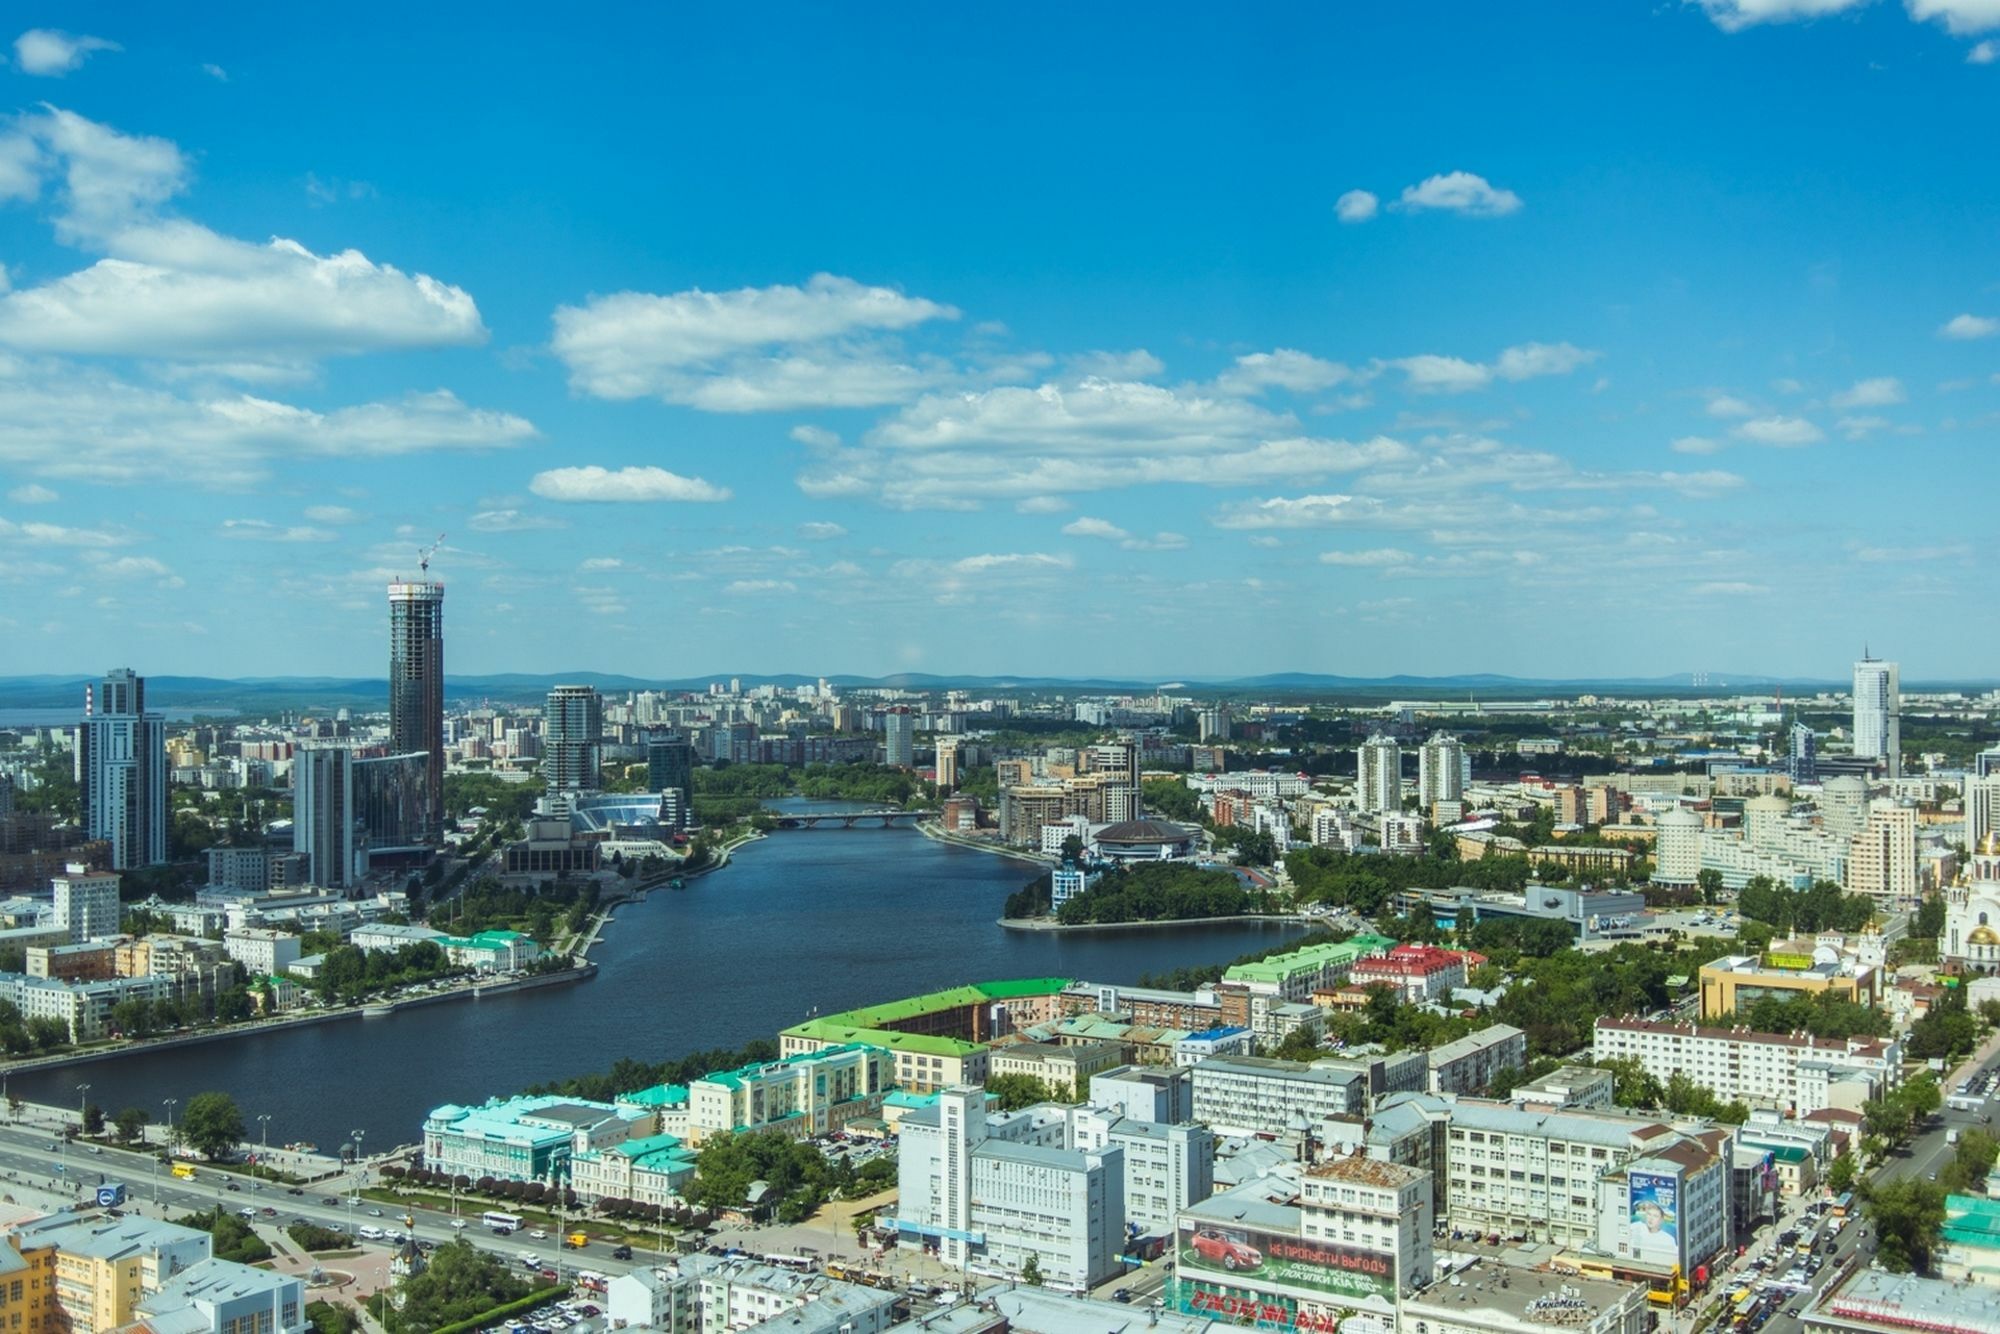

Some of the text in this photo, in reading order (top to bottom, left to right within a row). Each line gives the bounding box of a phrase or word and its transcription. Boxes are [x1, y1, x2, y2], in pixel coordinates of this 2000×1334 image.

[1268, 1243, 1387, 1273] НЕ ПРОПУСТИ ВЫГОДУ
[1290, 1262, 1327, 1275] ОСОБЫЕ
[1280, 1268, 1331, 1285] ПОКУПКИ
[1332, 1276, 1354, 1289] KIA
